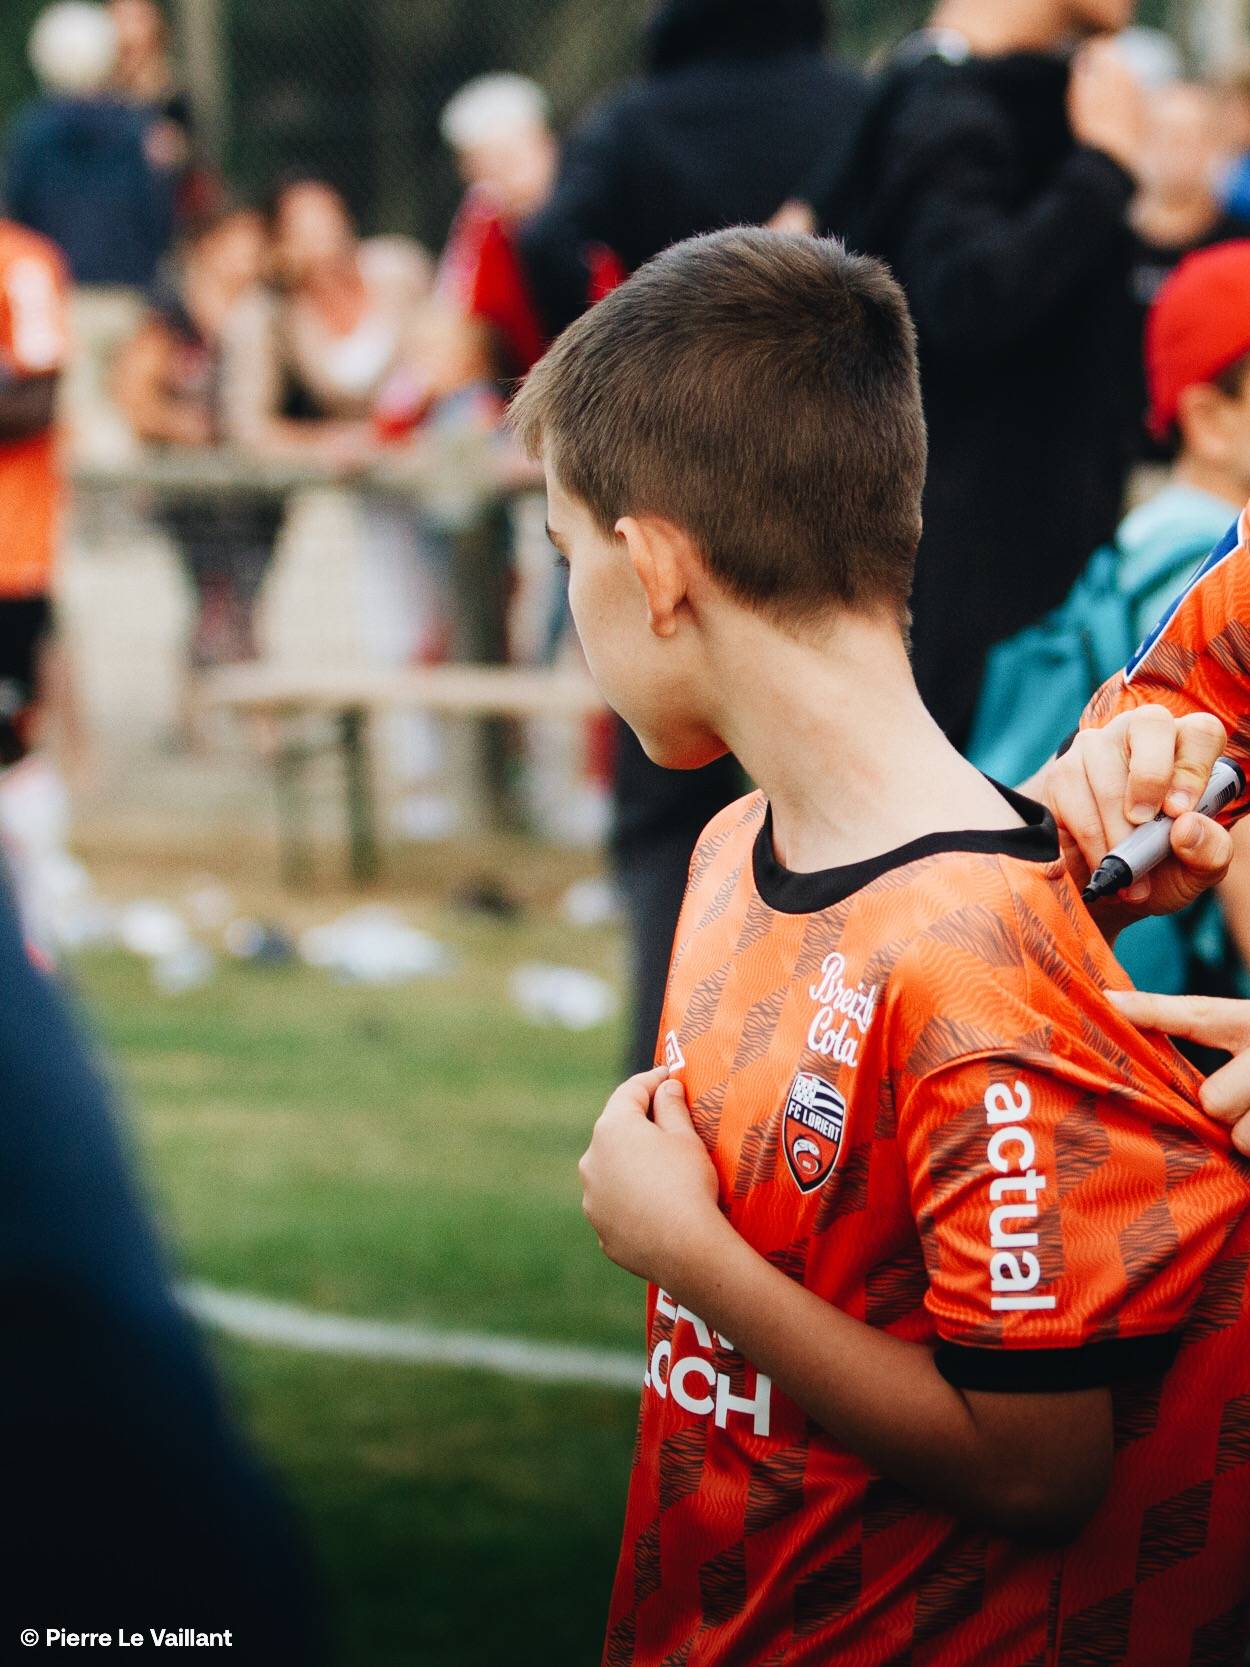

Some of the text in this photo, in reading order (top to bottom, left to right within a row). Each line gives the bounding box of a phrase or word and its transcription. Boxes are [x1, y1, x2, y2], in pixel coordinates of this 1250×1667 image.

[807, 1005, 859, 1068] Cola
[788, 1101, 840, 1142] FC LORIENT
[984, 1080, 1057, 1312] actual
